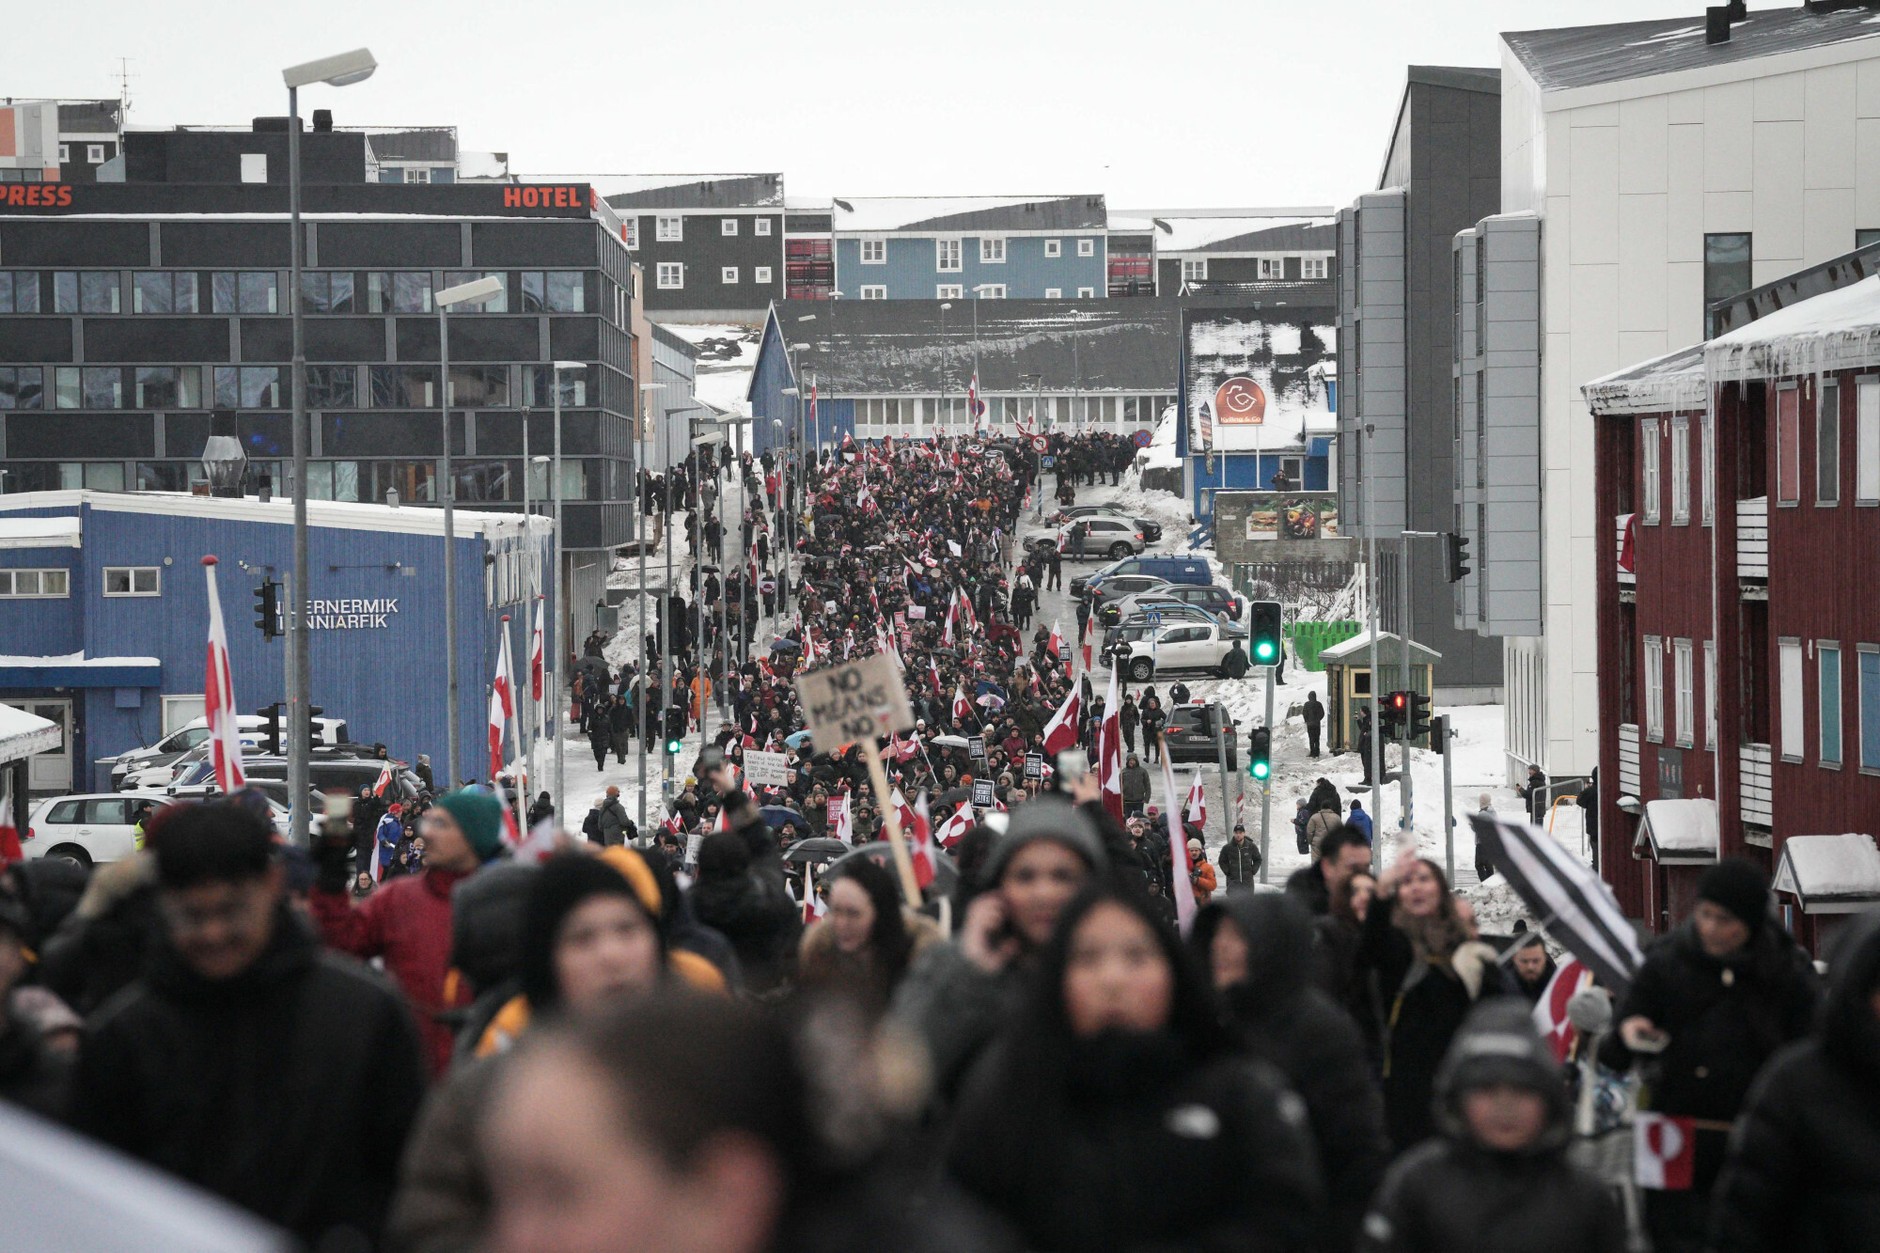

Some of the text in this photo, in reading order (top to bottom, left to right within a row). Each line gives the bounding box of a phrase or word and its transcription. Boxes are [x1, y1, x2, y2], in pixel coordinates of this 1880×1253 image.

[503, 186, 582, 208] HOTEL
[827, 667, 862, 695] NO
[811, 684, 888, 725] MEANS
[841, 715, 875, 740] NO
